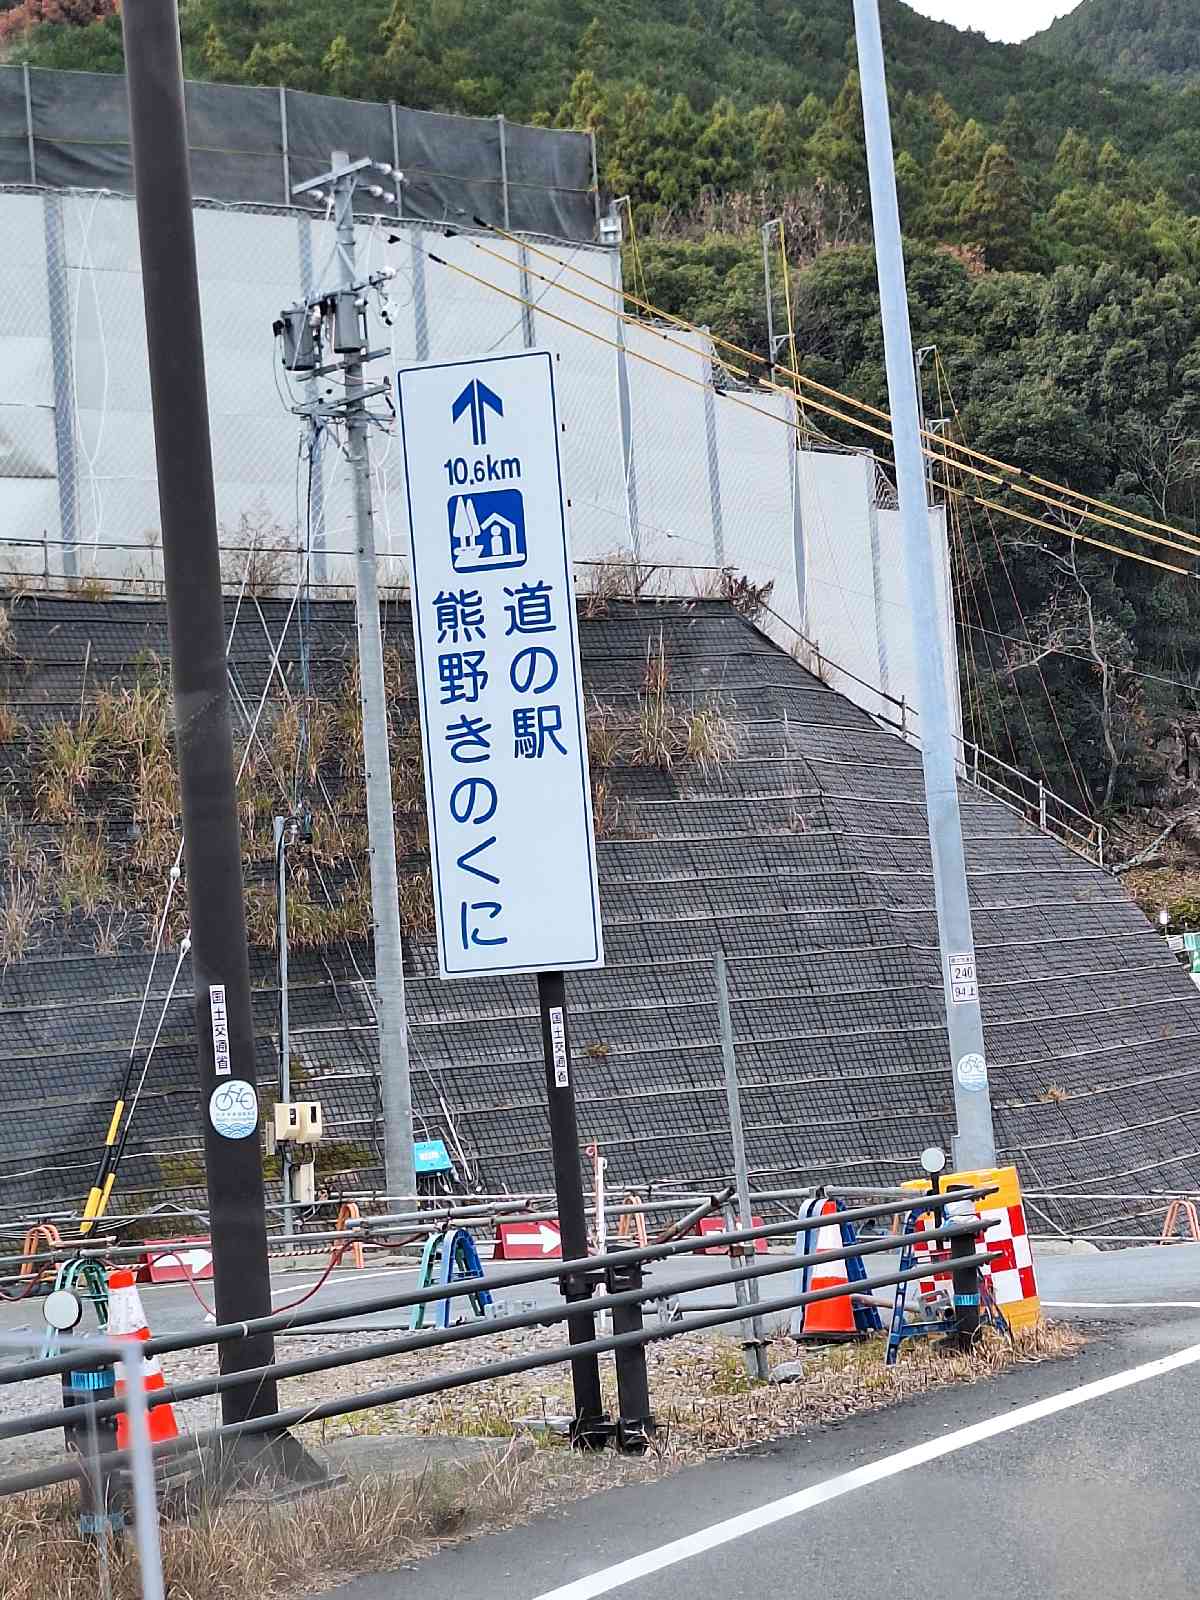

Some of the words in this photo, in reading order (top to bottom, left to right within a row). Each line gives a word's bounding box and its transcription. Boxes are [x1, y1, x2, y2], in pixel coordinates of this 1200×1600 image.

[443, 453, 521, 486] 10.6km
[503, 579, 568, 759] 道の駅
[431, 588, 508, 950] 熊野きのくに
[954, 966, 973, 979] 240
[211, 990, 229, 1069] 国土交通省
